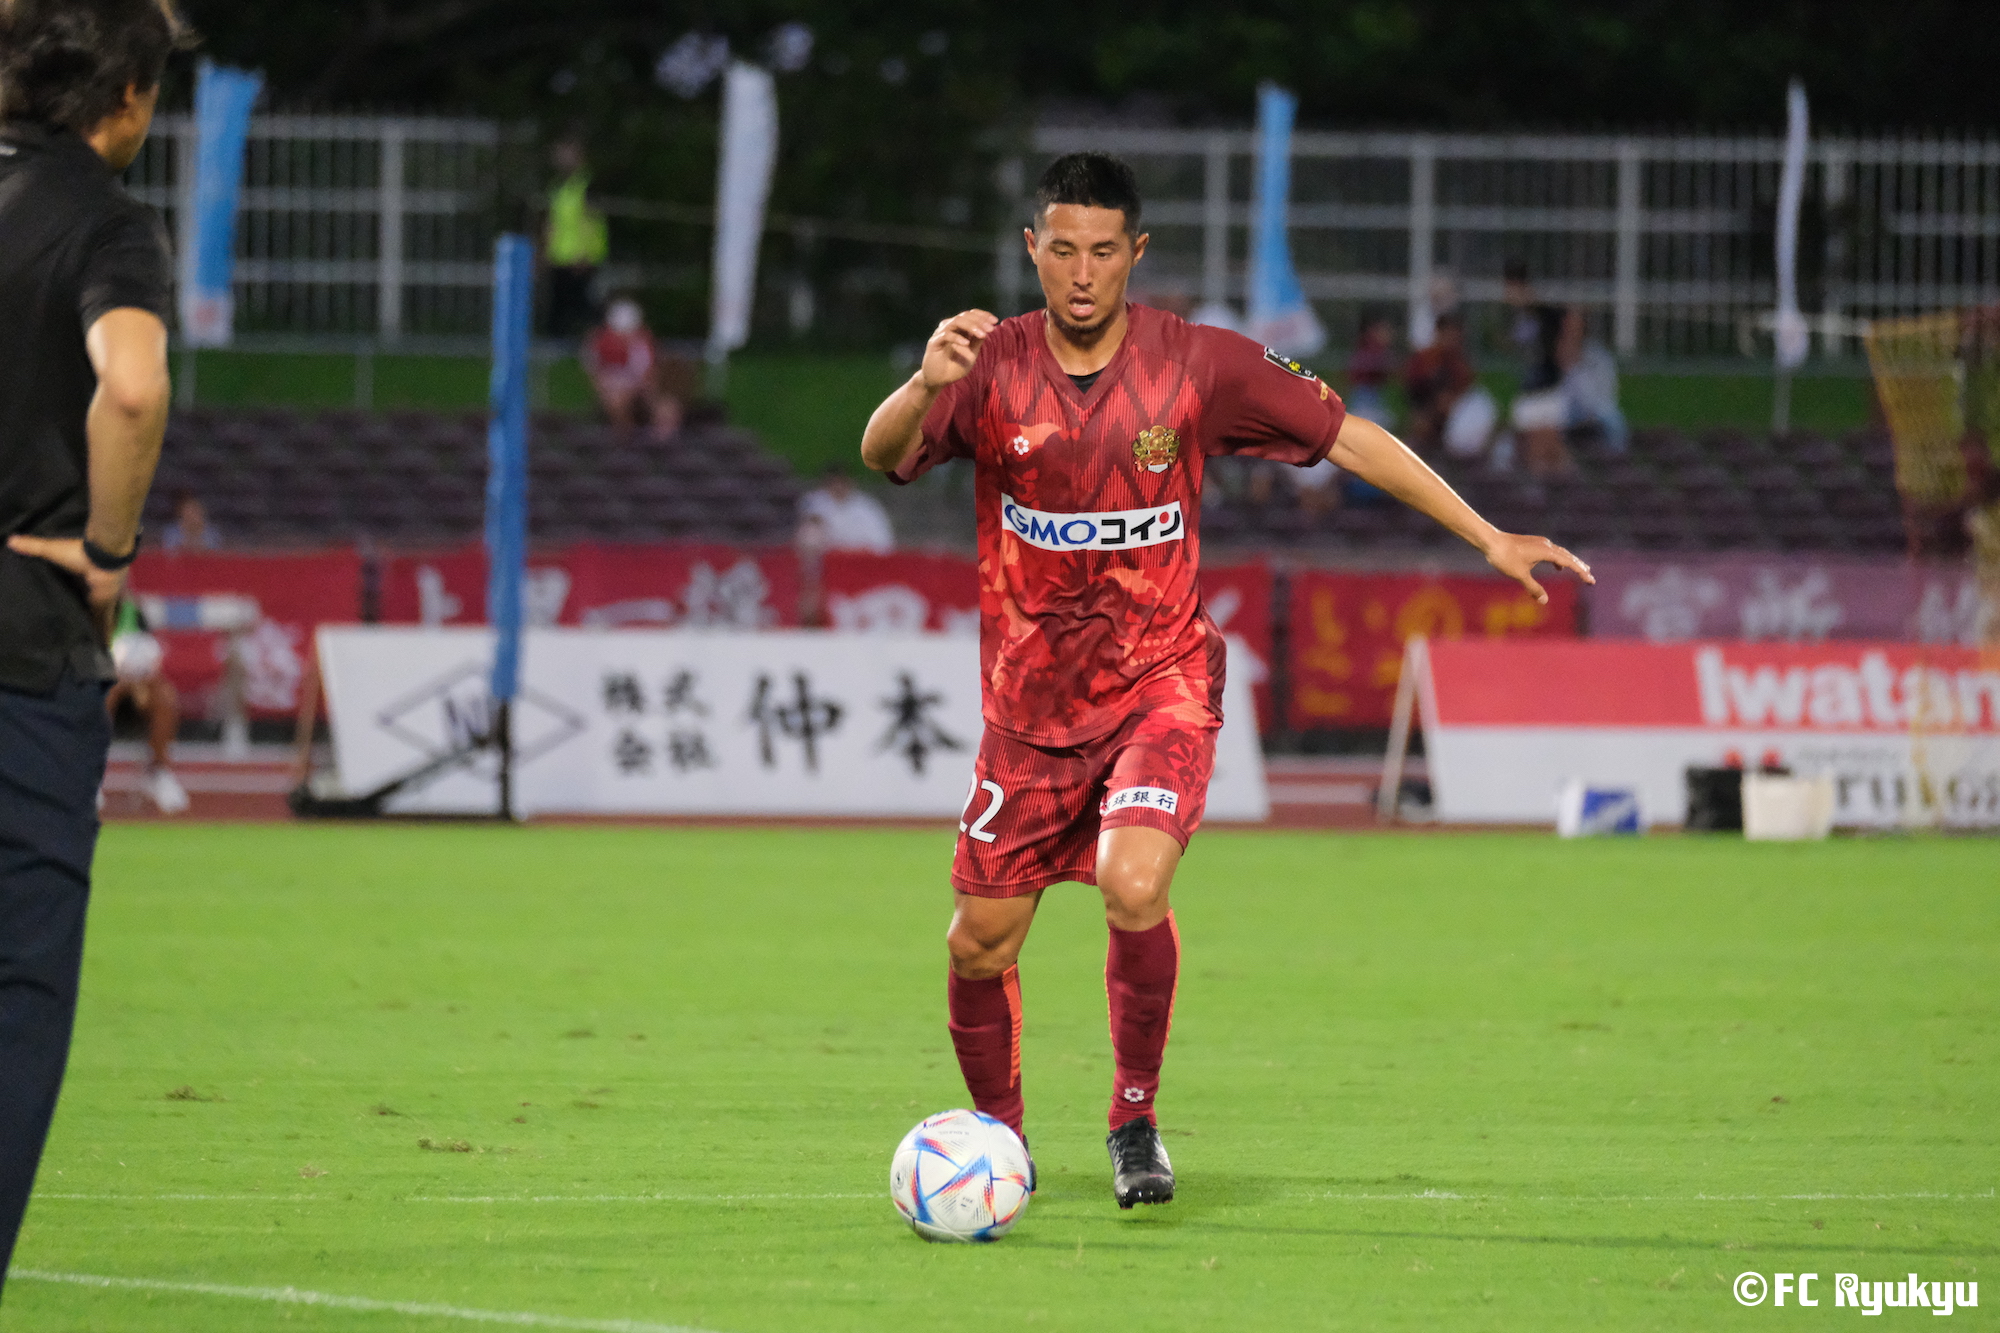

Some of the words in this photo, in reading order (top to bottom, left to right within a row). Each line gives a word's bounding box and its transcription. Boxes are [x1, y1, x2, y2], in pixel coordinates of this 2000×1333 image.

[1004, 504, 1182, 546] GMOコイン
[1107, 790, 1175, 810] 球銀行
